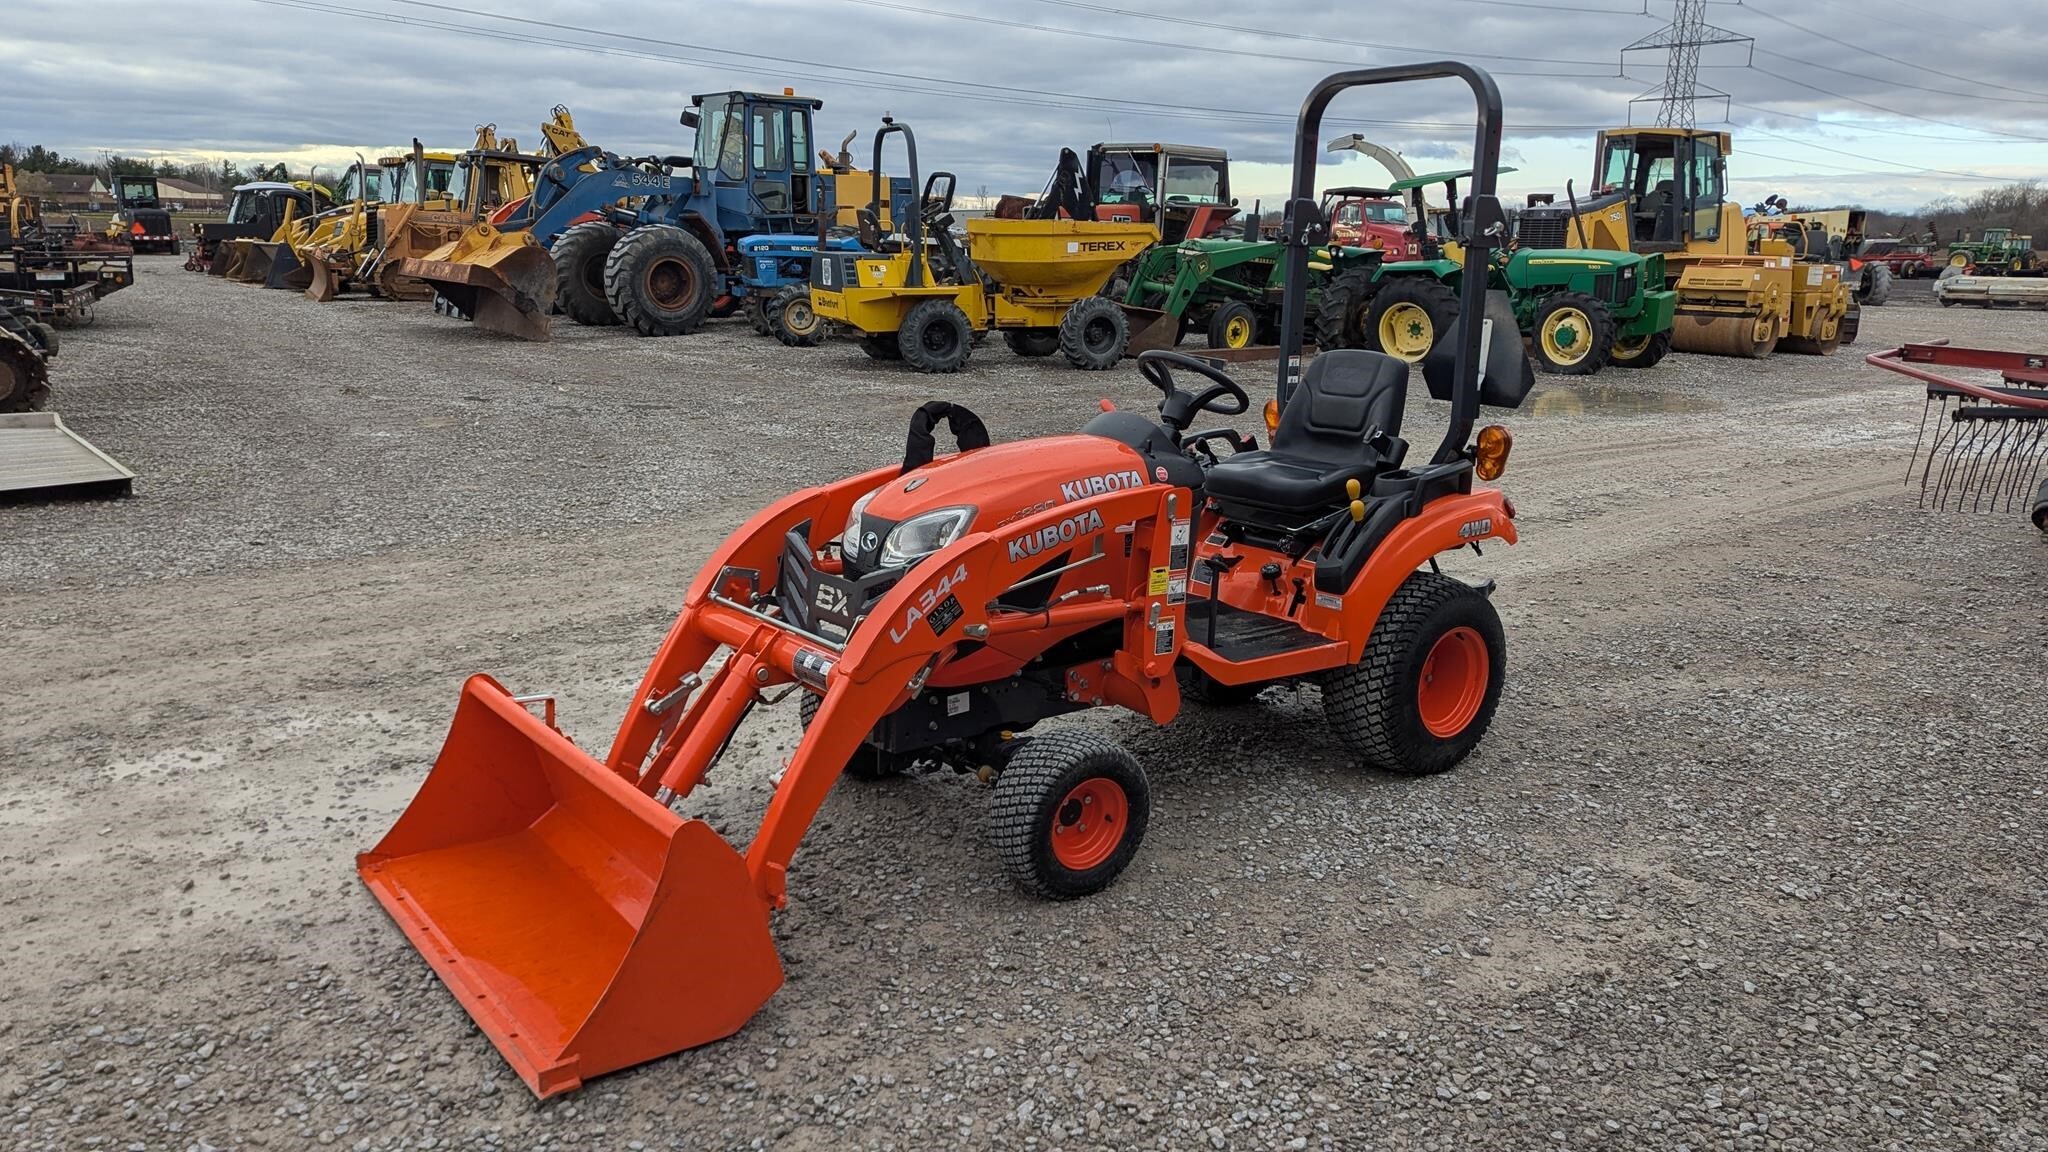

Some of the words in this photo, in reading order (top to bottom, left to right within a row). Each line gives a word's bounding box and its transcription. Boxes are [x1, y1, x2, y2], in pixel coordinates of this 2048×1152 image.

[551, 127, 571, 138] CAT
[432, 214, 459, 223] CASE
[1080, 241, 1125, 252] TEREX
[1060, 471, 1144, 502] KUBOTA
[1008, 508, 1105, 563] KUBOTA
[1458, 518, 1492, 538] 4WD
[816, 583, 848, 617] BX
[889, 563, 968, 644] LA344
